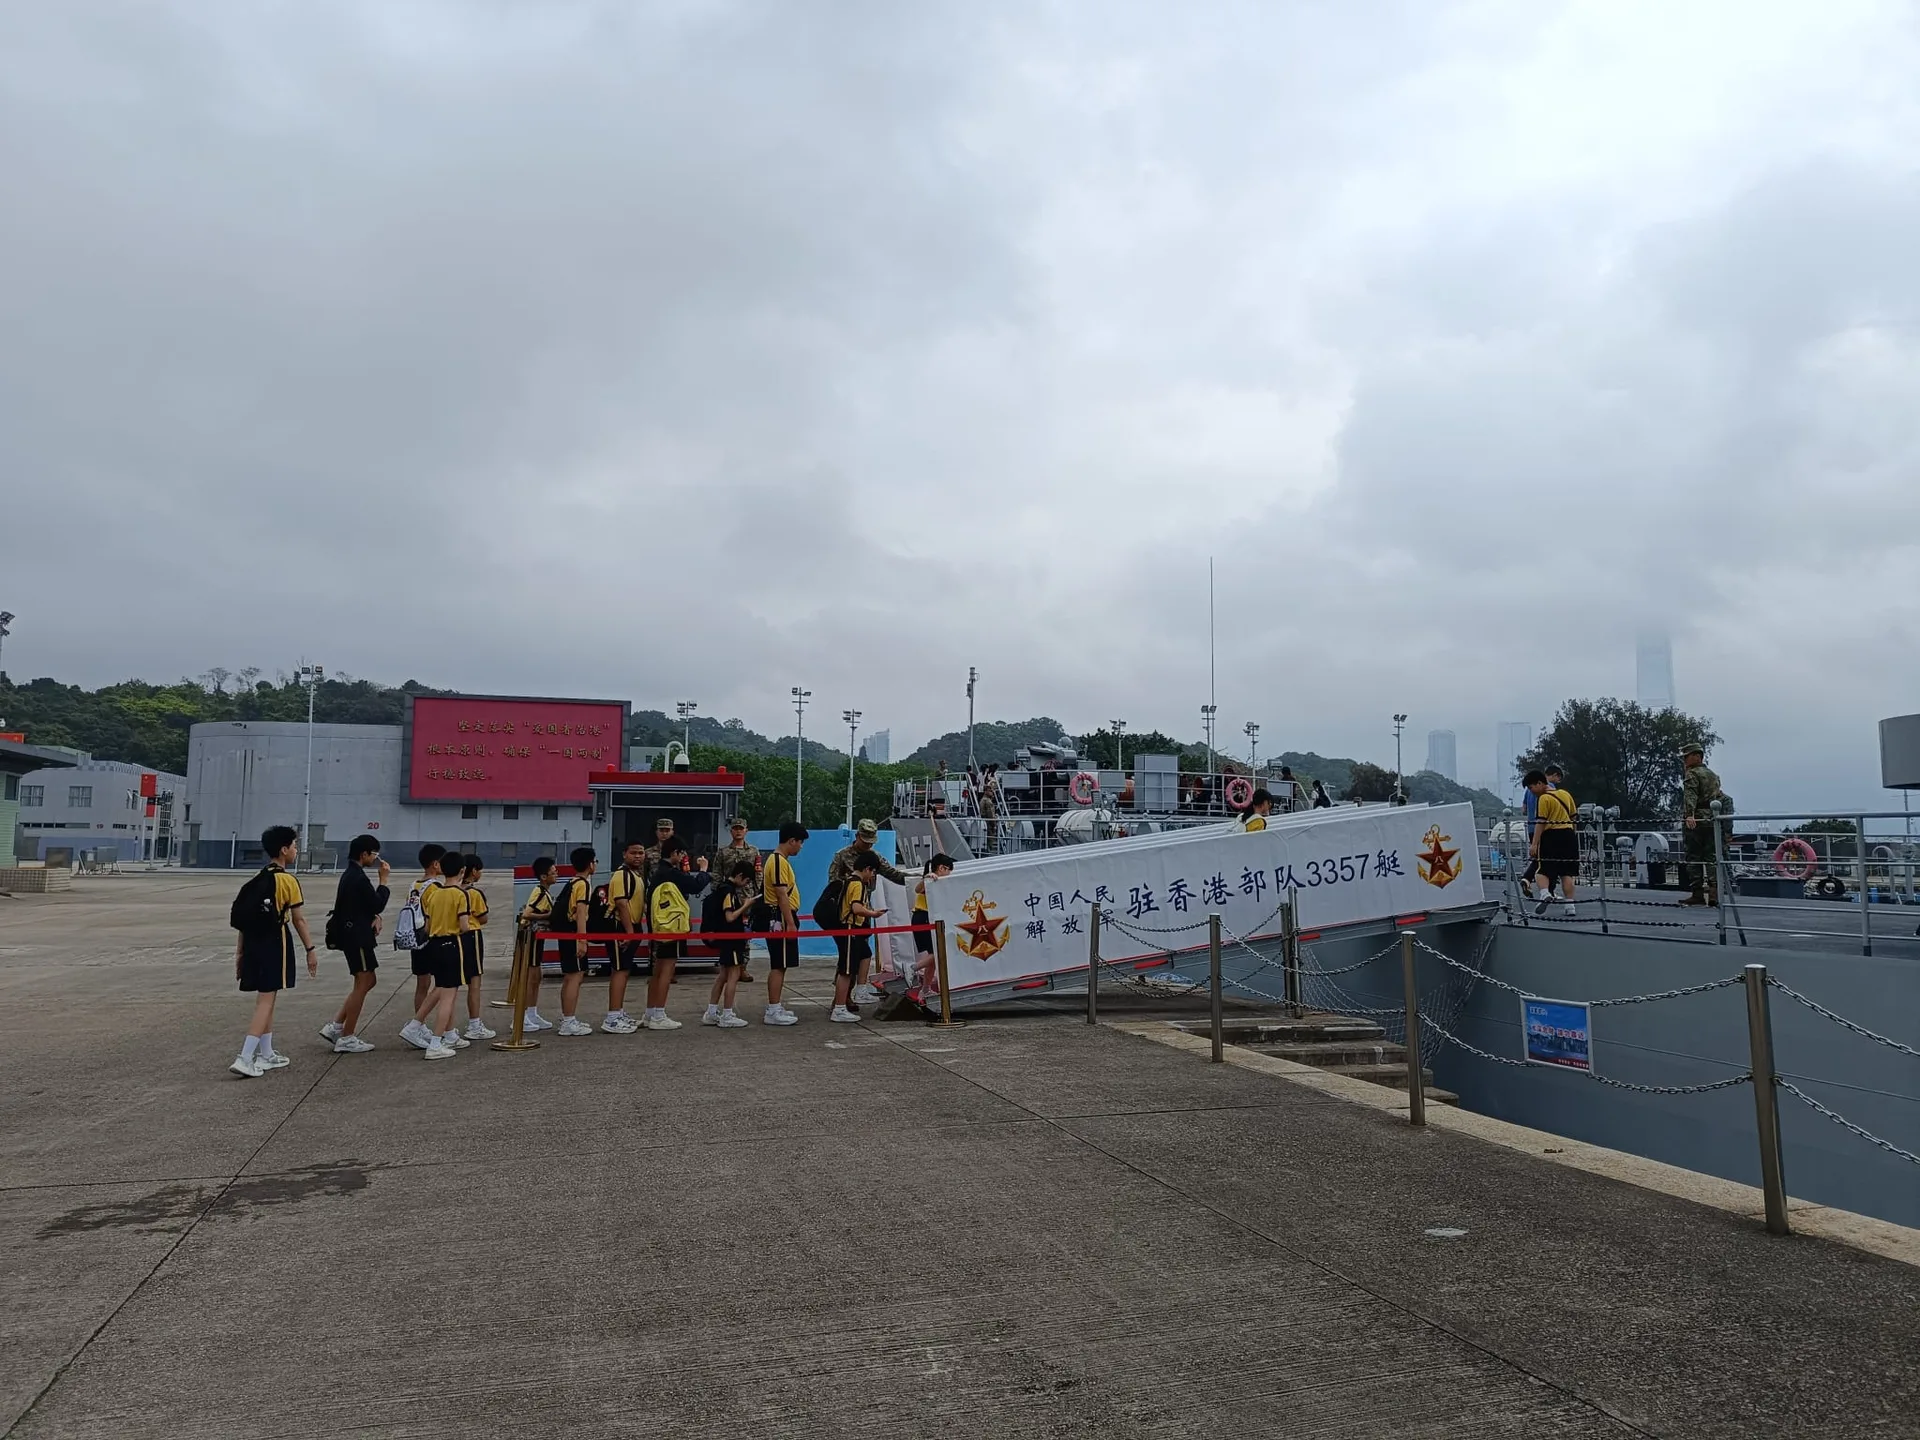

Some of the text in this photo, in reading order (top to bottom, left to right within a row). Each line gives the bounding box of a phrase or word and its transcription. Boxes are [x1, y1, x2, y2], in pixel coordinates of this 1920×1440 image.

[367, 822, 380, 830] 20
[1126, 849, 1405, 919] 驻香港部队3357艇
[1024, 885, 1114, 916] 中国人民
